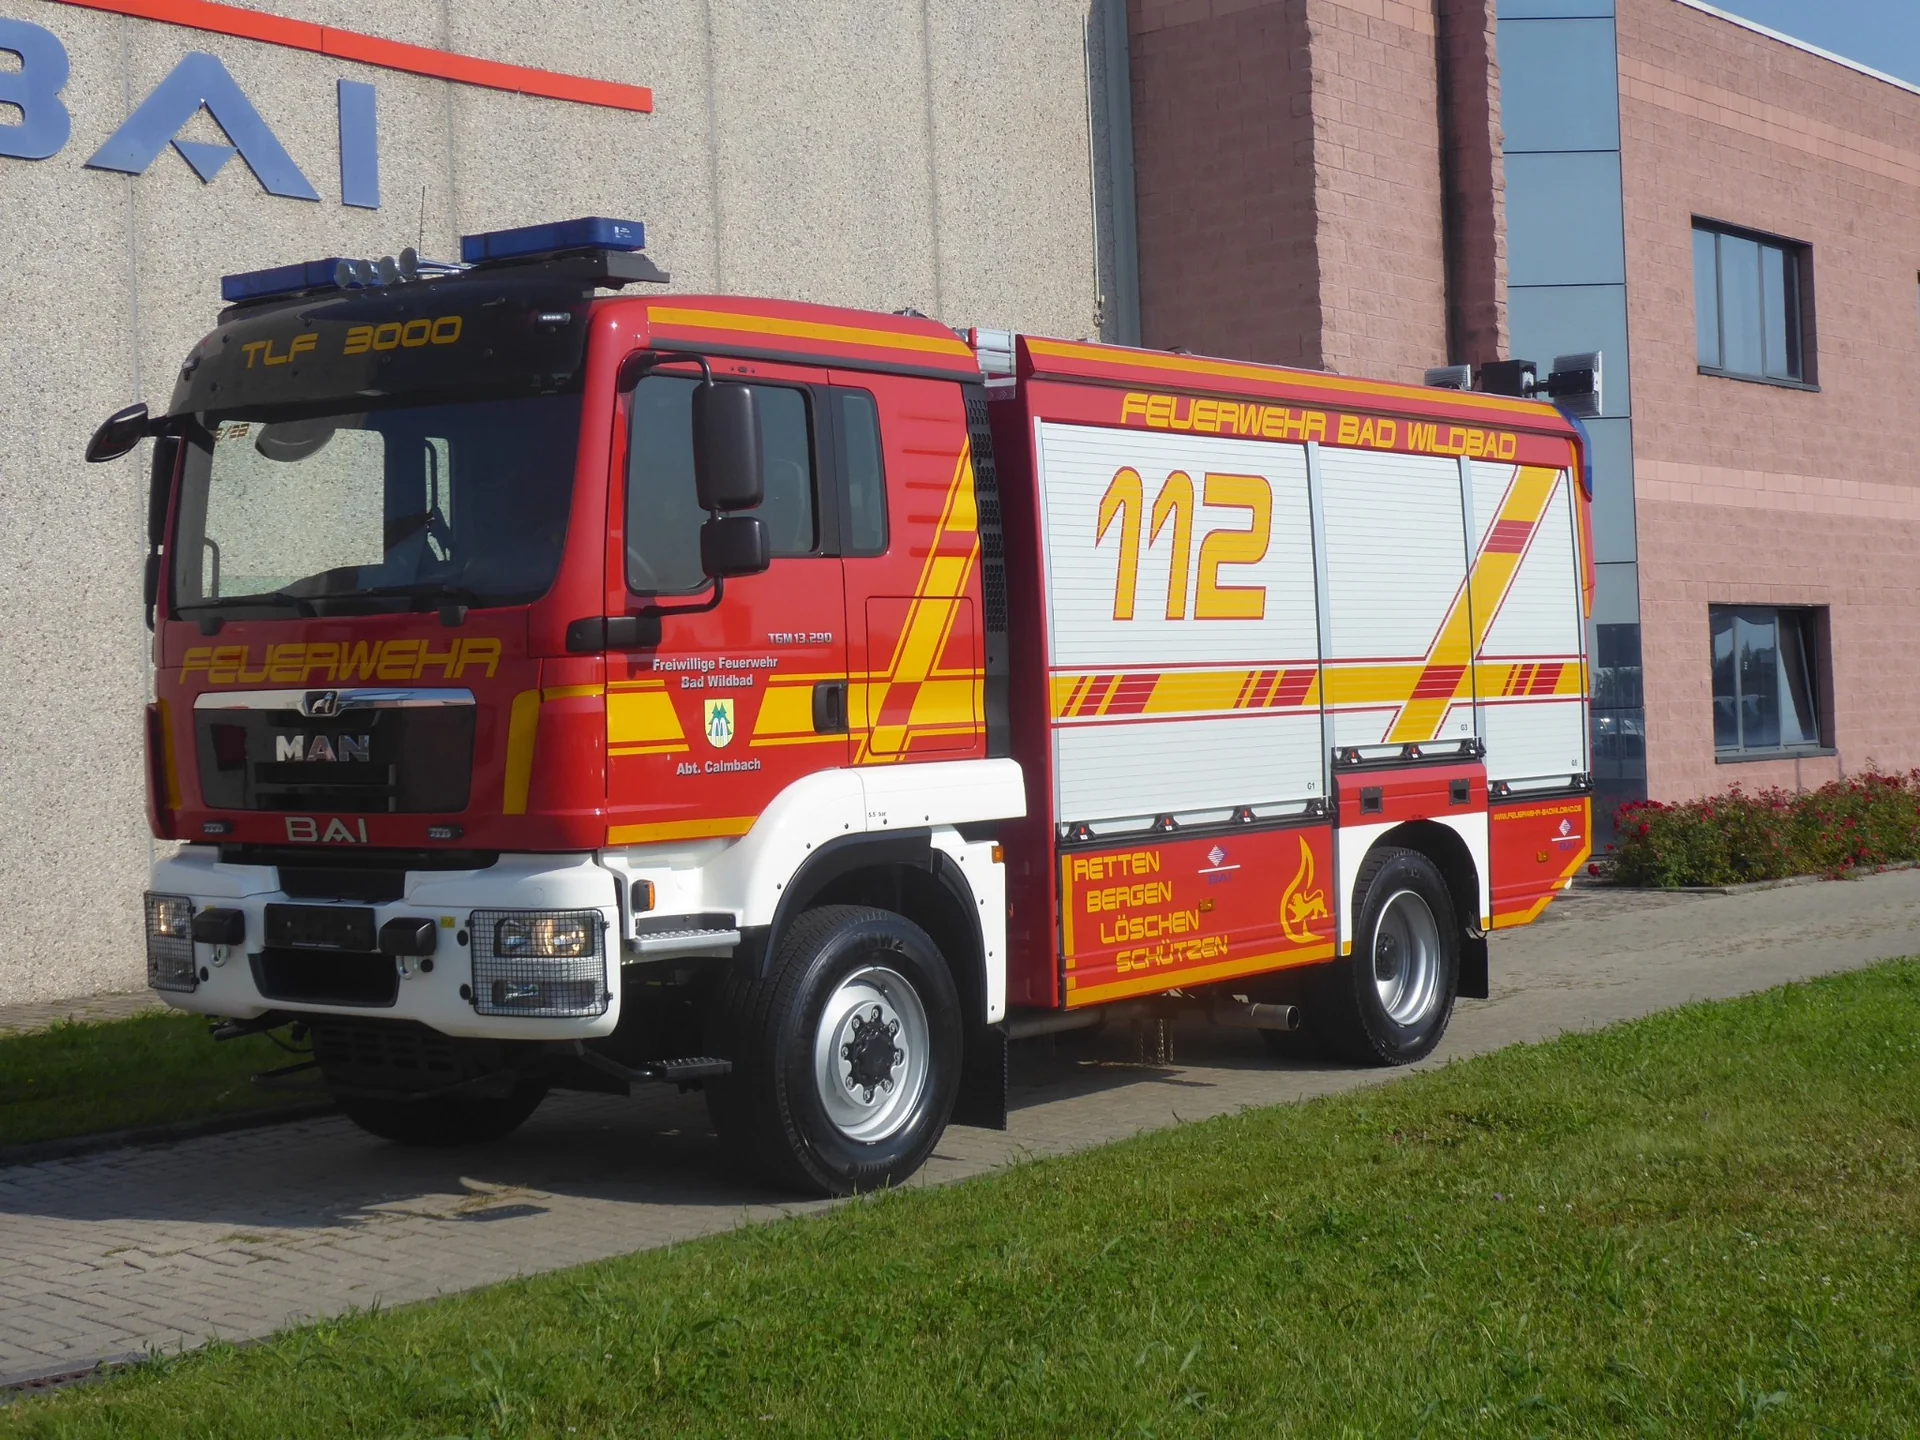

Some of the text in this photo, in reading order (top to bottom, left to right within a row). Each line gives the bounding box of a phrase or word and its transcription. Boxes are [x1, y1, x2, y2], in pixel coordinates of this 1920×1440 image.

[242, 315, 462, 368] TLF 3000
[1120, 392, 1517, 461] FEUERWEHR BAD WILDBAD
[1095, 466, 1273, 620] 112
[794, 632, 833, 644] 13.290
[179, 637, 501, 685] FEUERWEHR
[652, 656, 778, 673] Freiwillige Feuerwehr
[681, 674, 753, 689] Bad Wildbad
[275, 734, 370, 763] MAN
[676, 758, 761, 776] Abt. Calmbach
[1307, 782, 1315, 790] G1
[285, 816, 368, 843] BAI
[1073, 850, 1160, 882] RETTEN
[1086, 880, 1172, 913] BERGEN
[1100, 908, 1199, 944] LÖSCHEN
[1116, 934, 1229, 973] SCHÜTZEN
